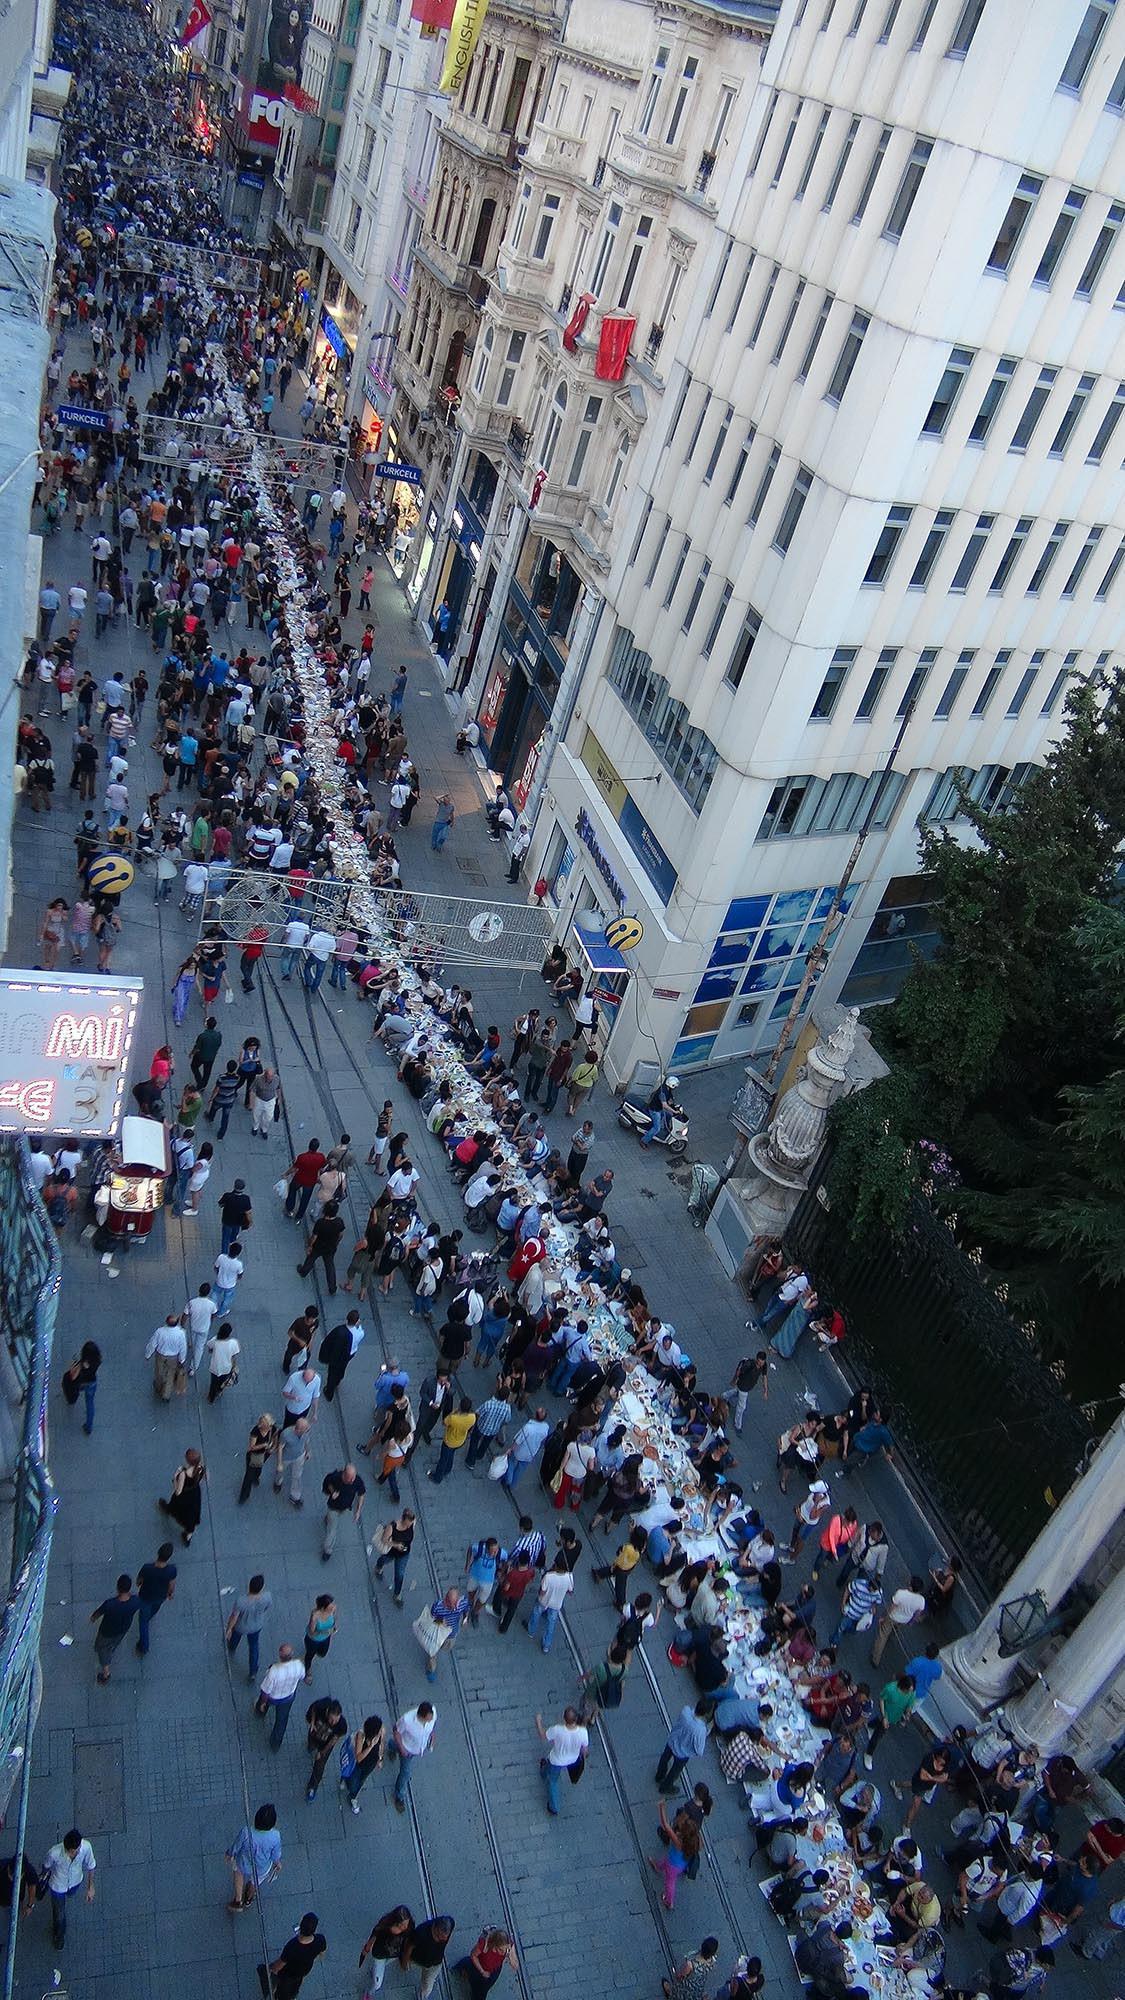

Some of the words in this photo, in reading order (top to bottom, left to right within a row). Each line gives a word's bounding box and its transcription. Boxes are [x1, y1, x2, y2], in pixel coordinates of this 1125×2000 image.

[450, 16, 476, 89] ENGLISH
[61, 410, 106, 427] TURKCELL
[379, 464, 418, 480] TURKCELL
[62, 1063, 116, 1081] KAT
[69, 1086, 99, 1123] 3
